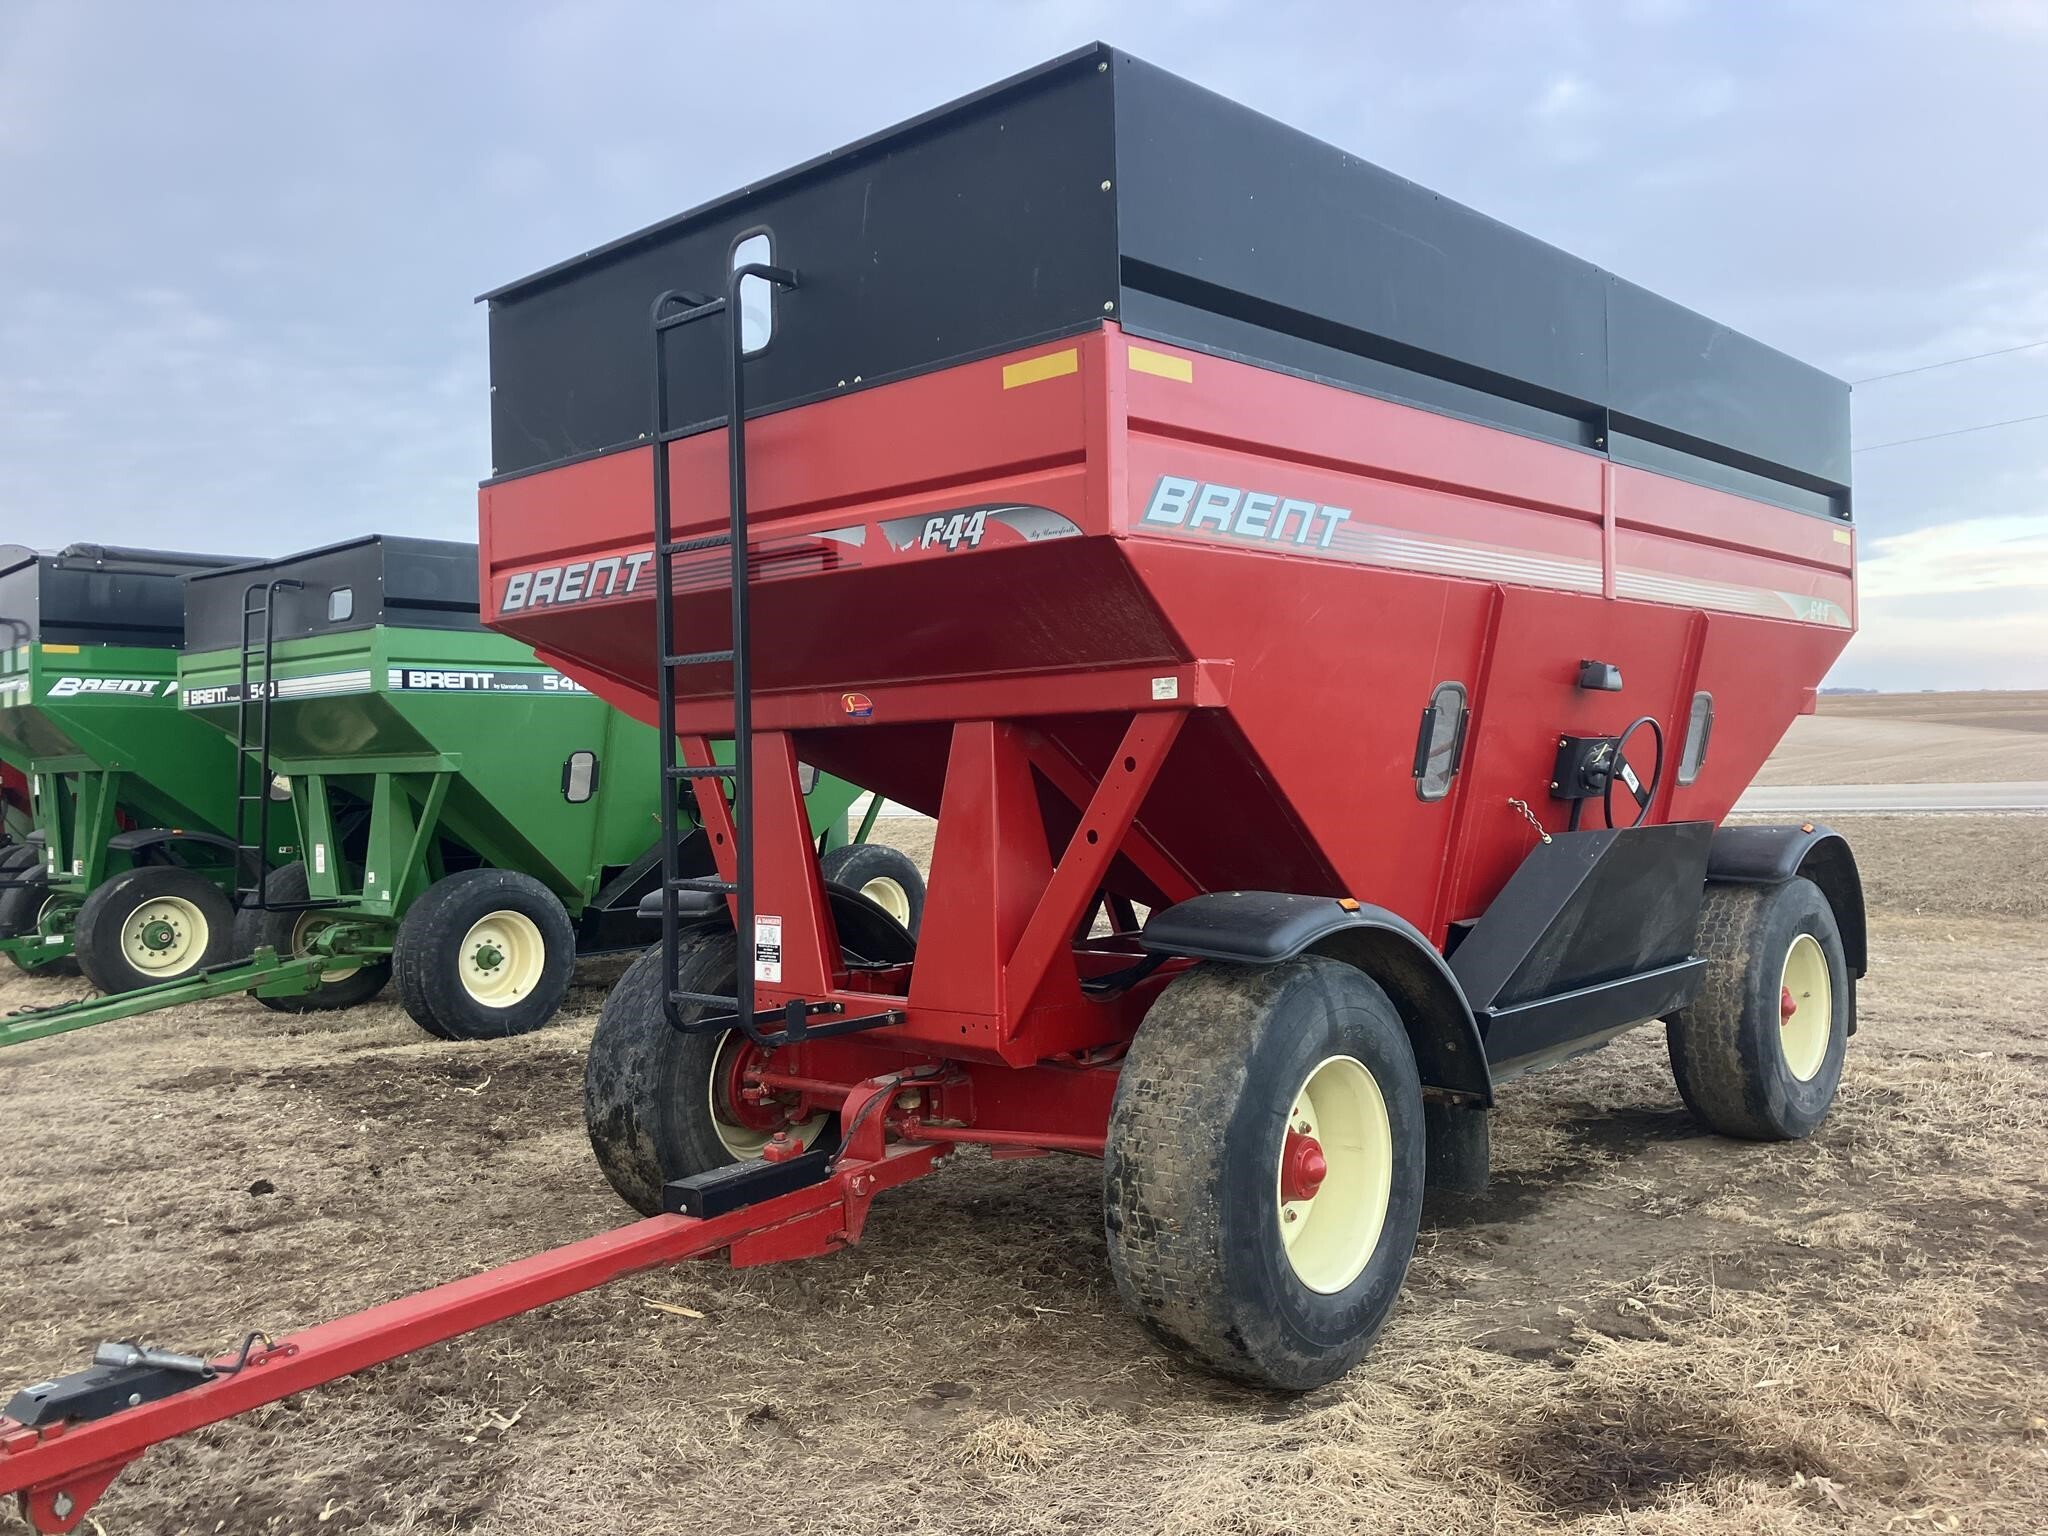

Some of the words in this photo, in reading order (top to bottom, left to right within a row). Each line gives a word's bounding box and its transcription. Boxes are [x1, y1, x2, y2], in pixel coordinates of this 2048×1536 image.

[1146, 475, 1352, 547] BRENT
[502, 551, 654, 611] BRENT
[46, 677, 160, 697] BRENT
[408, 671, 494, 689] BRENT
[190, 687, 228, 706] BRENT
